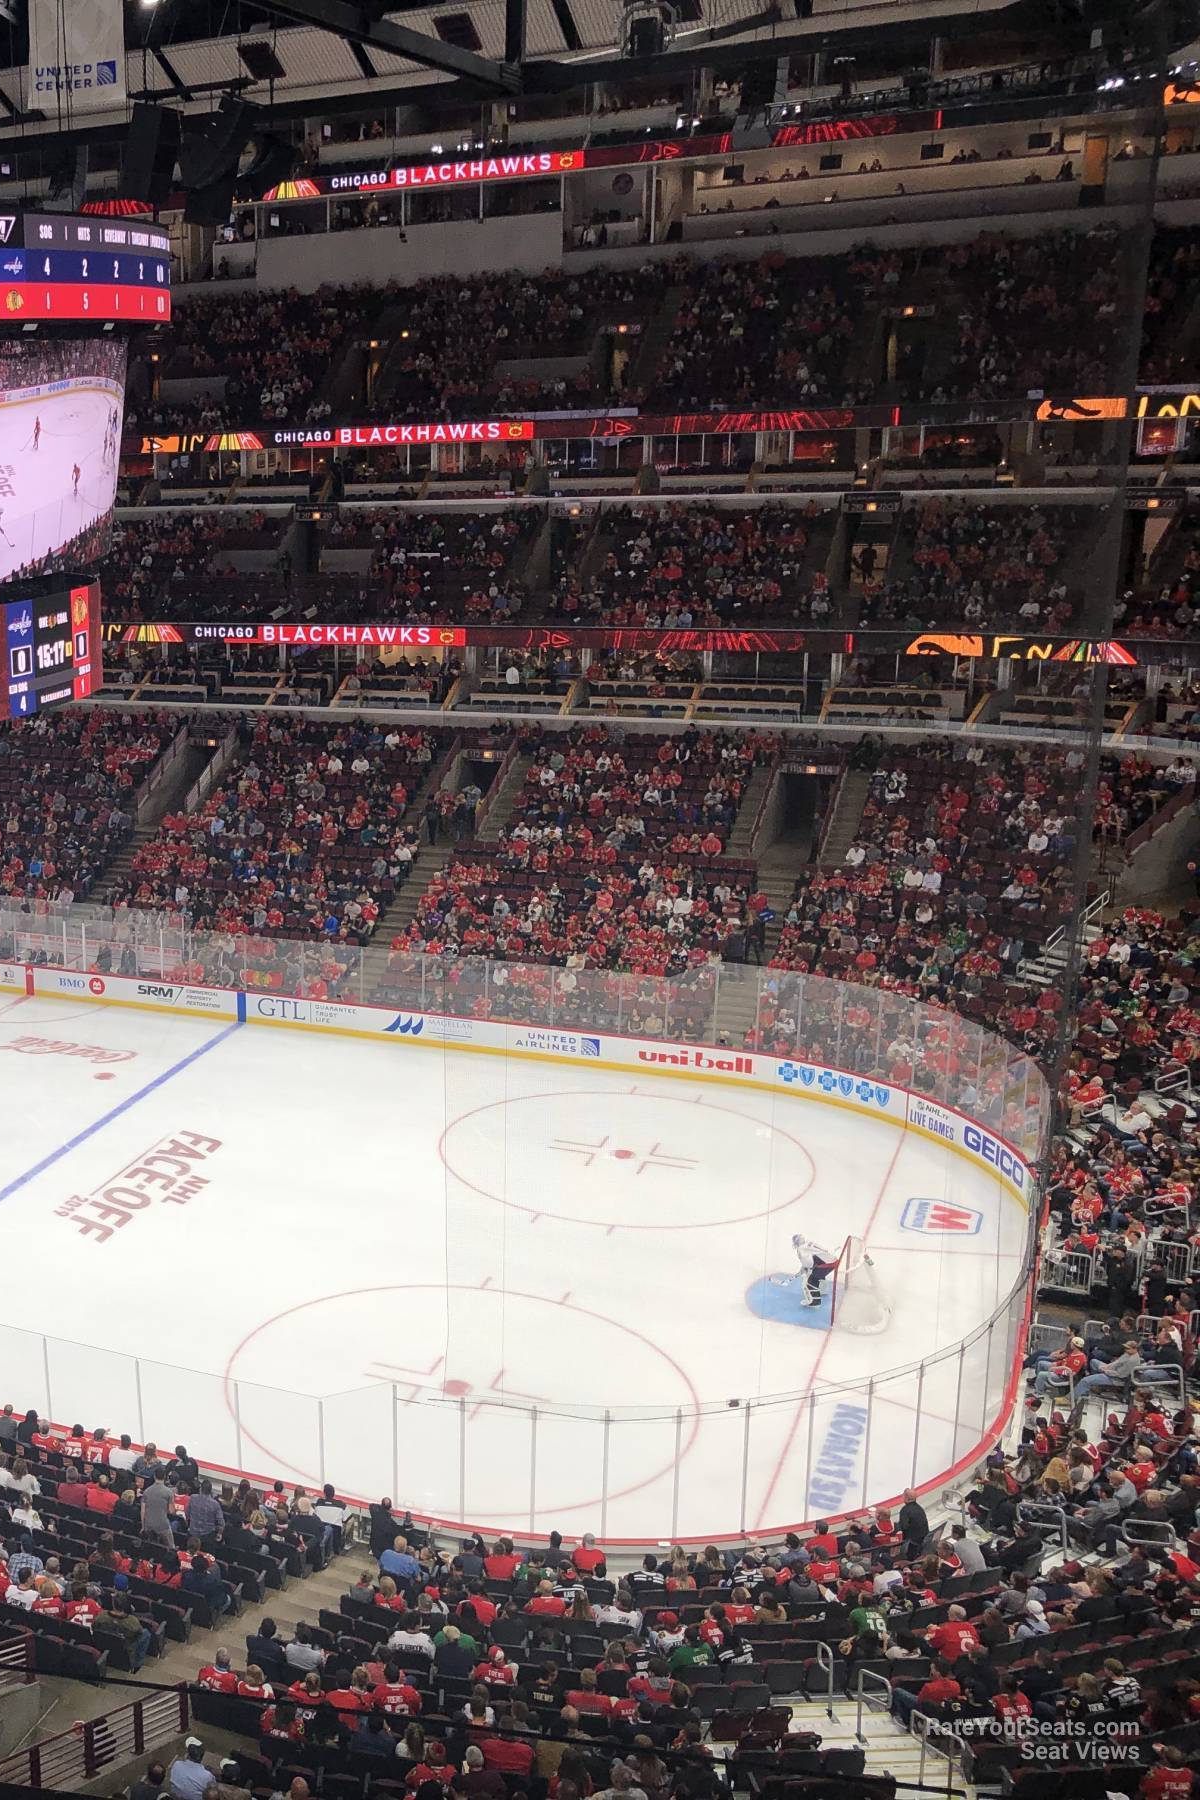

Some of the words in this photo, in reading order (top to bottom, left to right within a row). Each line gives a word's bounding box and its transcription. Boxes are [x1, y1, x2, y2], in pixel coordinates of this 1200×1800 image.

[35, 63, 92, 77] UNITED
[35, 78, 92, 91] CENTER
[331, 173, 388, 188] CHICAGO
[395, 154, 551, 185] BLACKHAWKS
[39, 224, 53, 239] SOG
[77, 227, 91, 241] HITS
[44, 257, 51, 276] 4
[82, 258, 88, 277] 2
[114, 260, 119, 279] 2
[139, 262, 144, 280] 2
[83, 292, 89, 310] 5
[274, 430, 333, 444] CHICAGO
[339, 422, 501, 445] BLACKHAWKS
[194, 626, 254, 638] CHICAGO
[263, 626, 431, 643] BLACKHAWKS
[37, 640, 65, 669] 15:17
[78, 635, 84, 656] 0
[17, 650, 26, 672] 0
[20, 695, 27, 711] 4
[58, 978, 86, 990] BMO
[137, 984, 173, 999] SRM
[257, 997, 306, 1021] GTL
[315, 1004, 357, 1015] GUARANTEE
[315, 1010, 338, 1019] TRUST
[515, 1039, 577, 1053] AIRLINES
[527, 1031, 577, 1045] UNITED
[638, 1050, 754, 1074] uni-ball
[909, 1109, 928, 1129] LIVE
[928, 1116, 955, 1141] GAMES
[963, 1125, 1025, 1189] GEICO
[70, 1130, 223, 1244] FACE-OFF
[160, 1175, 212, 1205] NHL
[53, 1194, 89, 1217] 2019
[808, 1403, 868, 1512] KOMATSU
